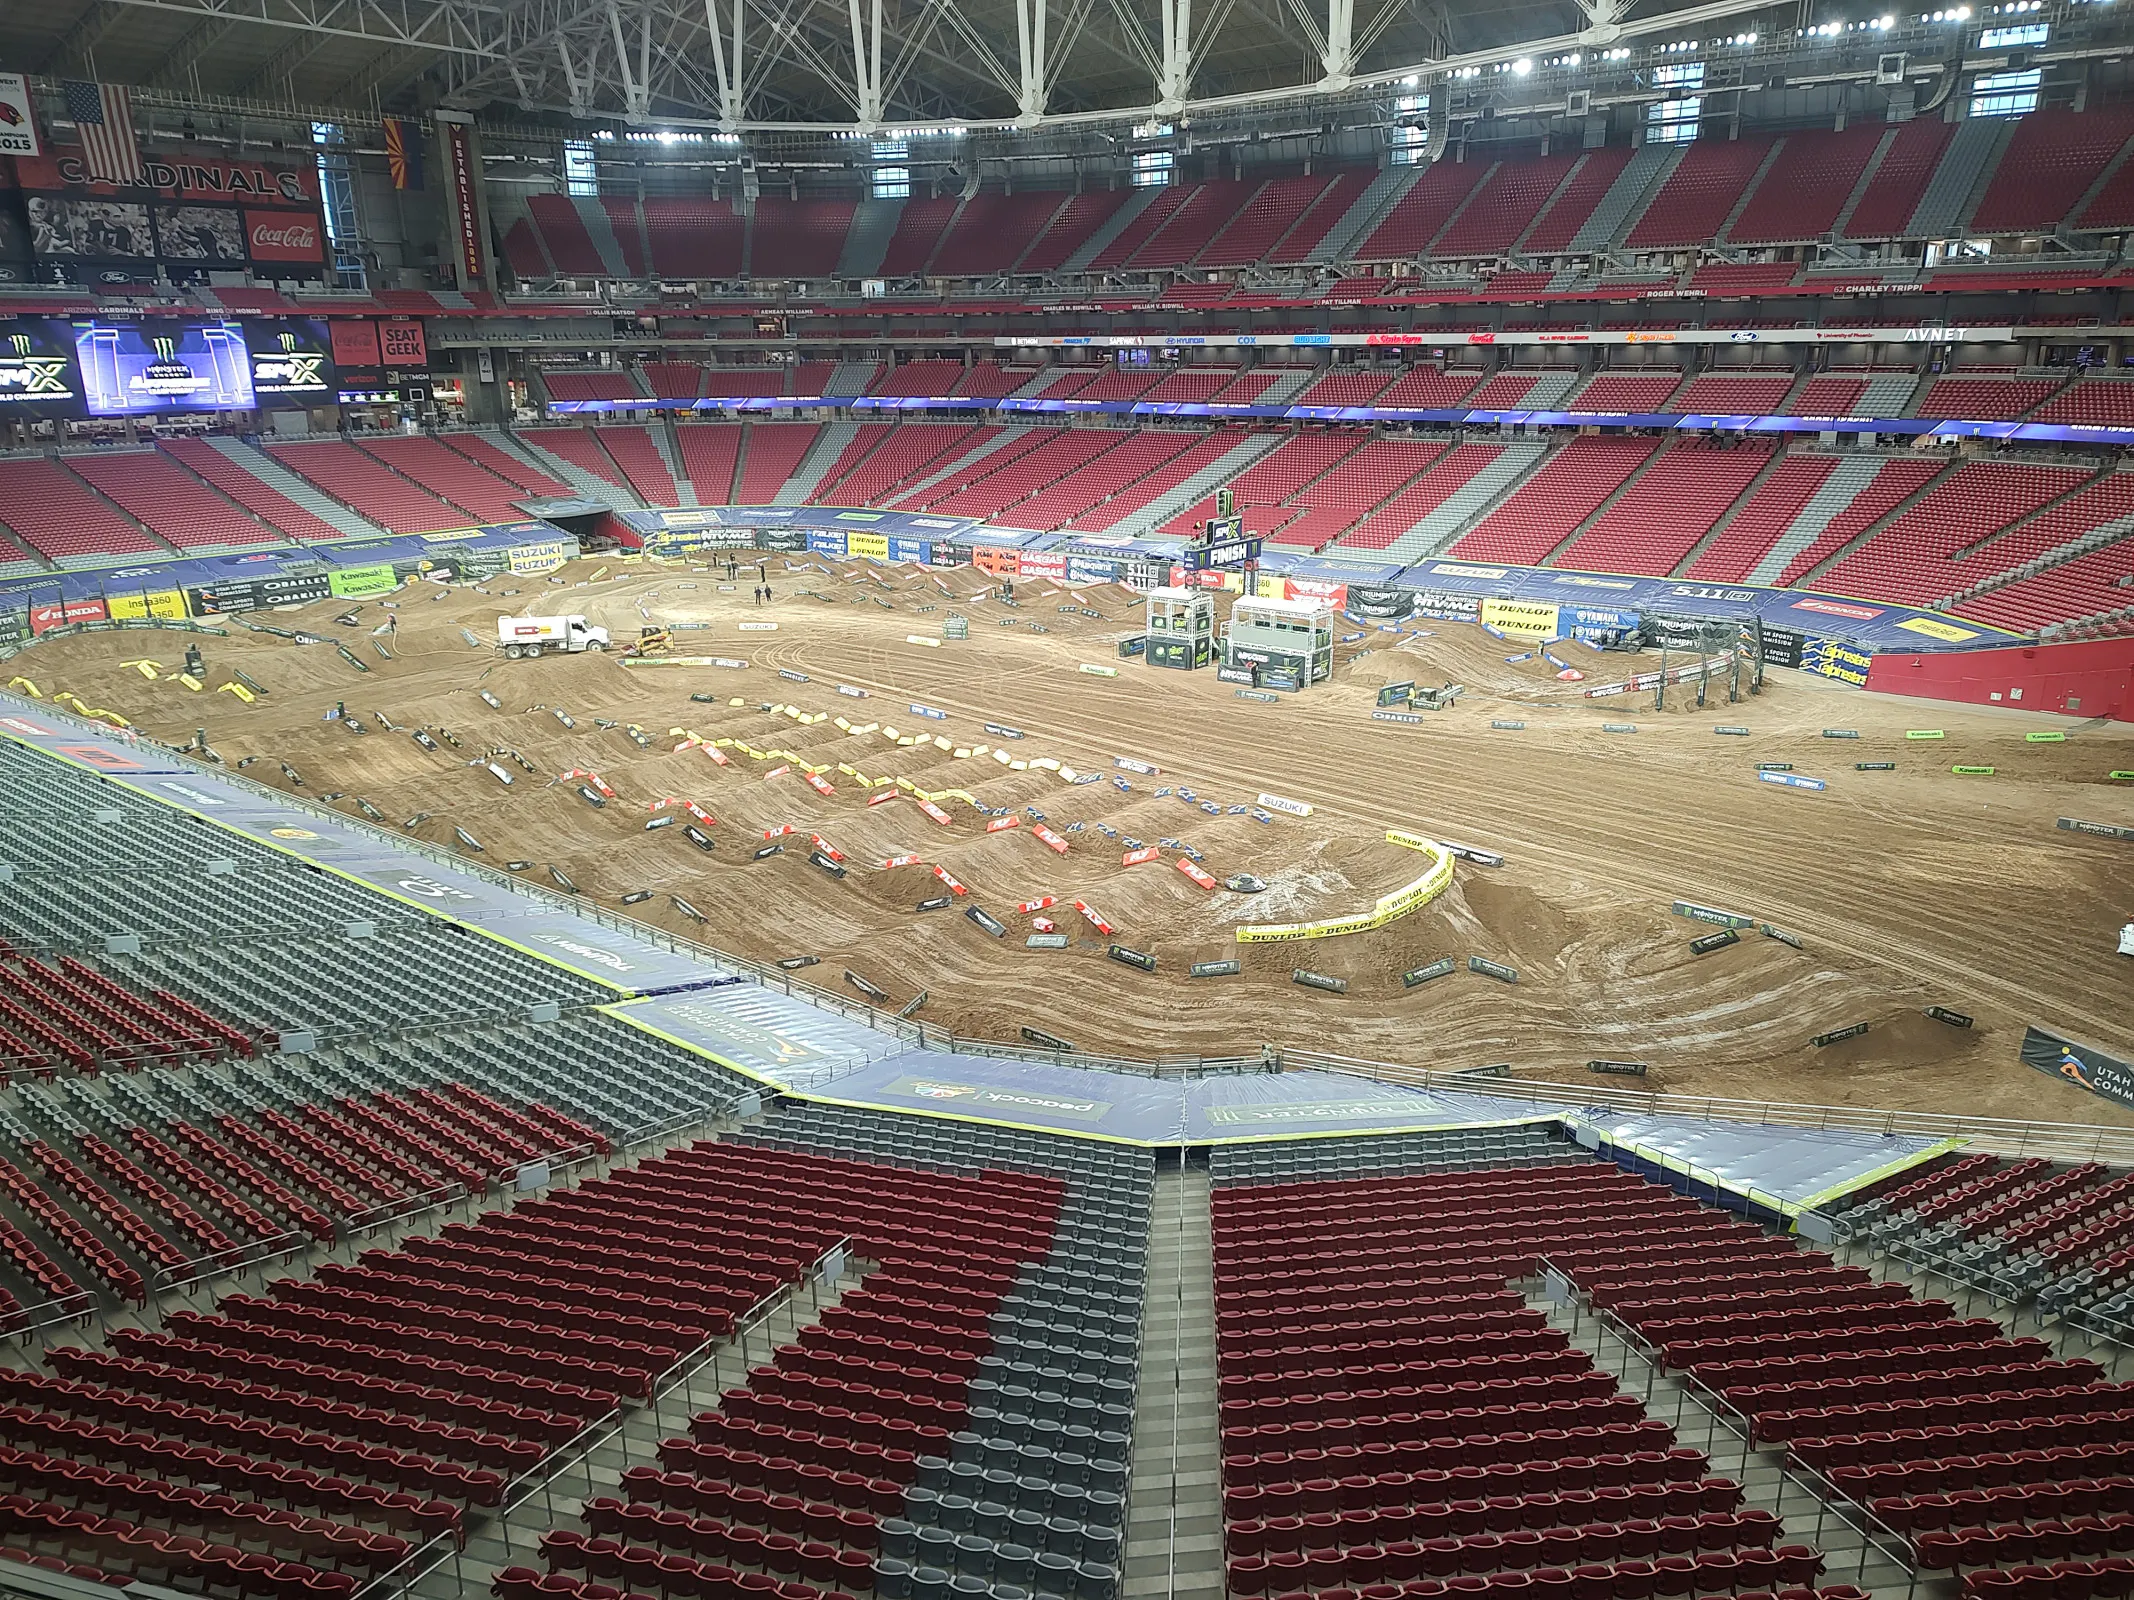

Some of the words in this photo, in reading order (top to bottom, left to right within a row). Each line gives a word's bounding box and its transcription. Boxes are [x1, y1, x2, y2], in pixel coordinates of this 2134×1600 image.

[455, 140, 473, 237] ESTABLISHED
[468, 239, 477, 273] 1898
[253, 224, 314, 247] Coca-Cola
[104, 271, 126, 282] Ford
[1647, 290, 1674, 298] ROGER
[1676, 289, 1708, 297] WEHRLI
[1845, 285, 1889, 293] CHARLEY
[1891, 284, 1923, 292] TRIPPI
[386, 328, 417, 342] SEAT
[1294, 336, 1310, 344] BUD
[1311, 336, 1331, 344] LIGHT
[1401, 335, 1422, 344] Farm
[1904, 328, 1968, 341] AVNET
[1109, 337, 1136, 346] SAFEWAY
[1237, 337, 1256, 345] COX
[387, 342, 422, 356] GEEK
[147, 365, 189, 374] MONSTER
[254, 358, 324, 384] SMX
[344, 375, 377, 384] verizon
[400, 373, 430, 381] BETMGM
[280, 384, 328, 392] CHAMPIONSHIP
[768, 530, 791, 538] TRIUMPH
[812, 530, 845, 538] FALKEN
[1215, 521, 1240, 539] SMX
[768, 541, 791, 549] TRIUMPH
[813, 542, 845, 550] FALKEN
[856, 537, 886, 545] DUNLOP
[512, 545, 561, 559] SUZUKI
[856, 548, 886, 556] DUNLOP
[903, 552, 920, 560] YAMAHA
[1211, 543, 1247, 566] FINISH
[1020, 553, 1064, 565] GASGAS
[1076, 558, 1112, 572] Husqvarna
[340, 569, 383, 581] Kawasaki
[1020, 566, 1064, 578] GASGAS
[1127, 563, 1148, 577] 5.11
[232, 583, 252, 591] SPORTS
[280, 576, 329, 589] OAKLEY
[343, 582, 385, 594] Kawasaki
[1126, 576, 1148, 589] 5.11
[216, 588, 252, 597] COMMISSION
[283, 589, 330, 601] OAKLEY
[1360, 590, 1392, 600] TRIUMPH
[1424, 592, 1446, 601] ROCKY
[1446, 595, 1479, 604] MOUNTAIN
[1672, 585, 1724, 600] 5.11
[219, 602, 254, 612] COMMISSION
[234, 597, 254, 605] SPORTS
[52, 606, 102, 619] HONDA
[1360, 604, 1392, 615] TRIUMPH
[1422, 607, 1443, 616] ROCKY
[1498, 604, 1554, 616] DUNLOP
[1815, 602, 1874, 618] HONDA
[1585, 612, 1619, 623] YAMAHA
[1496, 620, 1552, 632] DUNLOP
[1656, 619, 1693, 630] TRIUMPH
[1771, 632, 1793, 641] SPORTS
[1770, 650, 1791, 658] SPORTS
[1825, 644, 1872, 668] alpinestars
[1820, 659, 1867, 685] alpinestars
[1385, 713, 1421, 723] OAKLEY
[2032, 733, 2061, 741] Kawasaki
[1959, 766, 1990, 775] Kawasaki
[1262, 796, 1303, 814] SUZUKI
[770, 826, 784, 839] FLY
[2079, 823, 2114, 834] MONSTER
[1392, 834, 1423, 848] DUNLOP
[1428, 868, 1448, 888] DUNLOP
[1026, 901, 1044, 912] FLY
[1082, 908, 1102, 925] FLY
[1693, 910, 1729, 923] MONSTER
[1326, 921, 1377, 935] DUNLOP
[1251, 932, 1306, 941] DUNLOP
[1702, 934, 1728, 945] MONSTER
[555, 939, 636, 972] TRIUMPH
[1120, 949, 1145, 962] MONSTER
[1201, 963, 1228, 971] MONSTER
[1413, 964, 1442, 977] MONSTER
[1482, 961, 1508, 974] MONSTER
[1306, 973, 1334, 984] MONSTER
[664, 1006, 717, 1028] SPORTS
[1942, 1012, 1964, 1023] MONSTER
[677, 1005, 768, 1042] COMMISSION
[716, 1028, 755, 1044] UTAH
[1830, 1028, 1858, 1040] MONSTER
[2097, 1065, 2131, 1087] UTAH
[986, 1092, 1095, 1112] peacock
[1252, 1105, 1393, 1119] MONSTER
